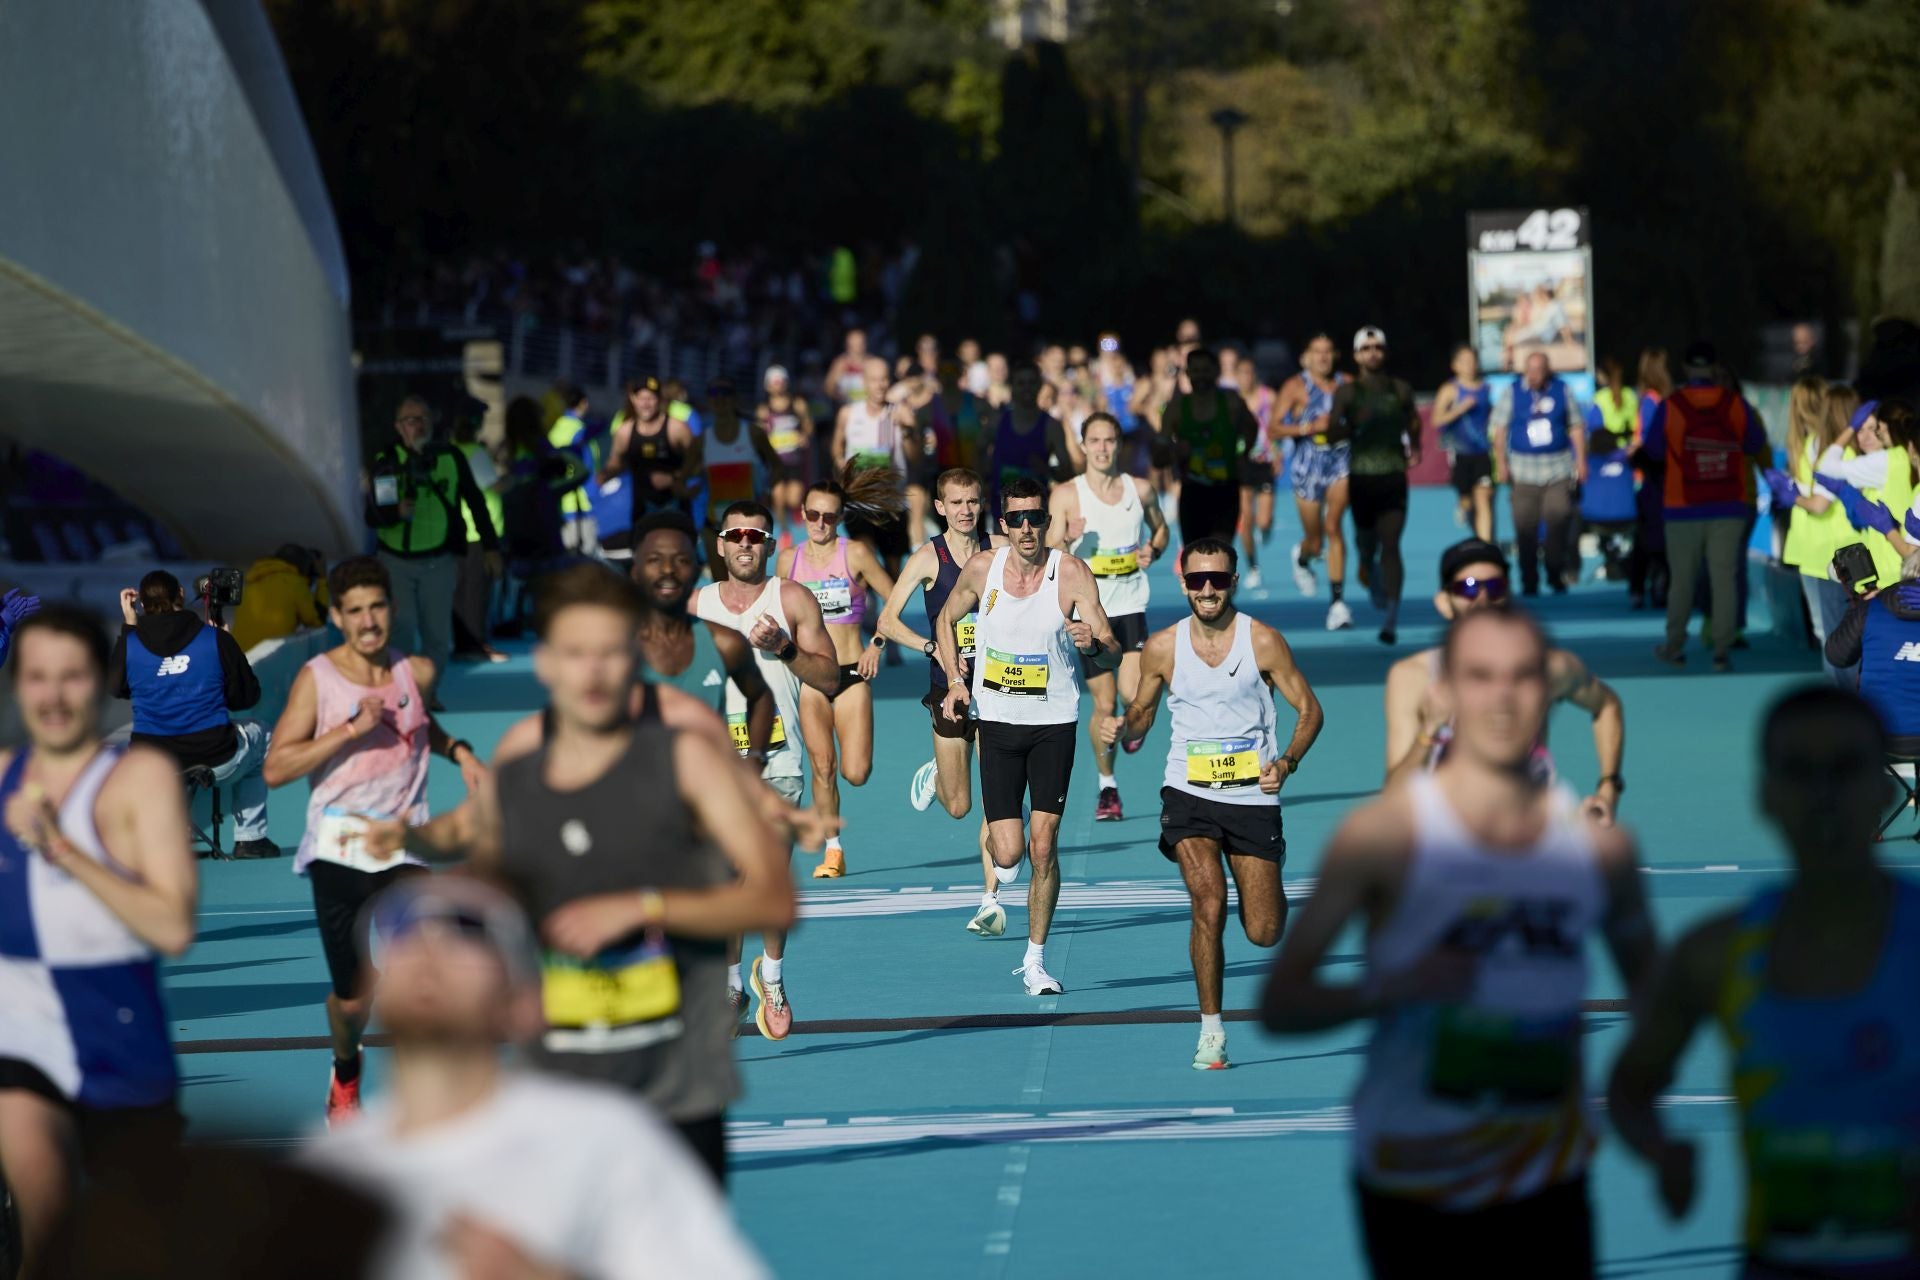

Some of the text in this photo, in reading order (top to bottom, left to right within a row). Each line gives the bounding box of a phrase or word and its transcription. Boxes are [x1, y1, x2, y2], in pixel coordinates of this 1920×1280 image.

[1517, 208, 1580, 251] 42
[157, 655, 190, 676] NB
[1004, 667, 1022, 676] 445
[1001, 676, 1025, 686] Forest
[1209, 756, 1236, 768] 1148
[1212, 770, 1236, 780] Samy
